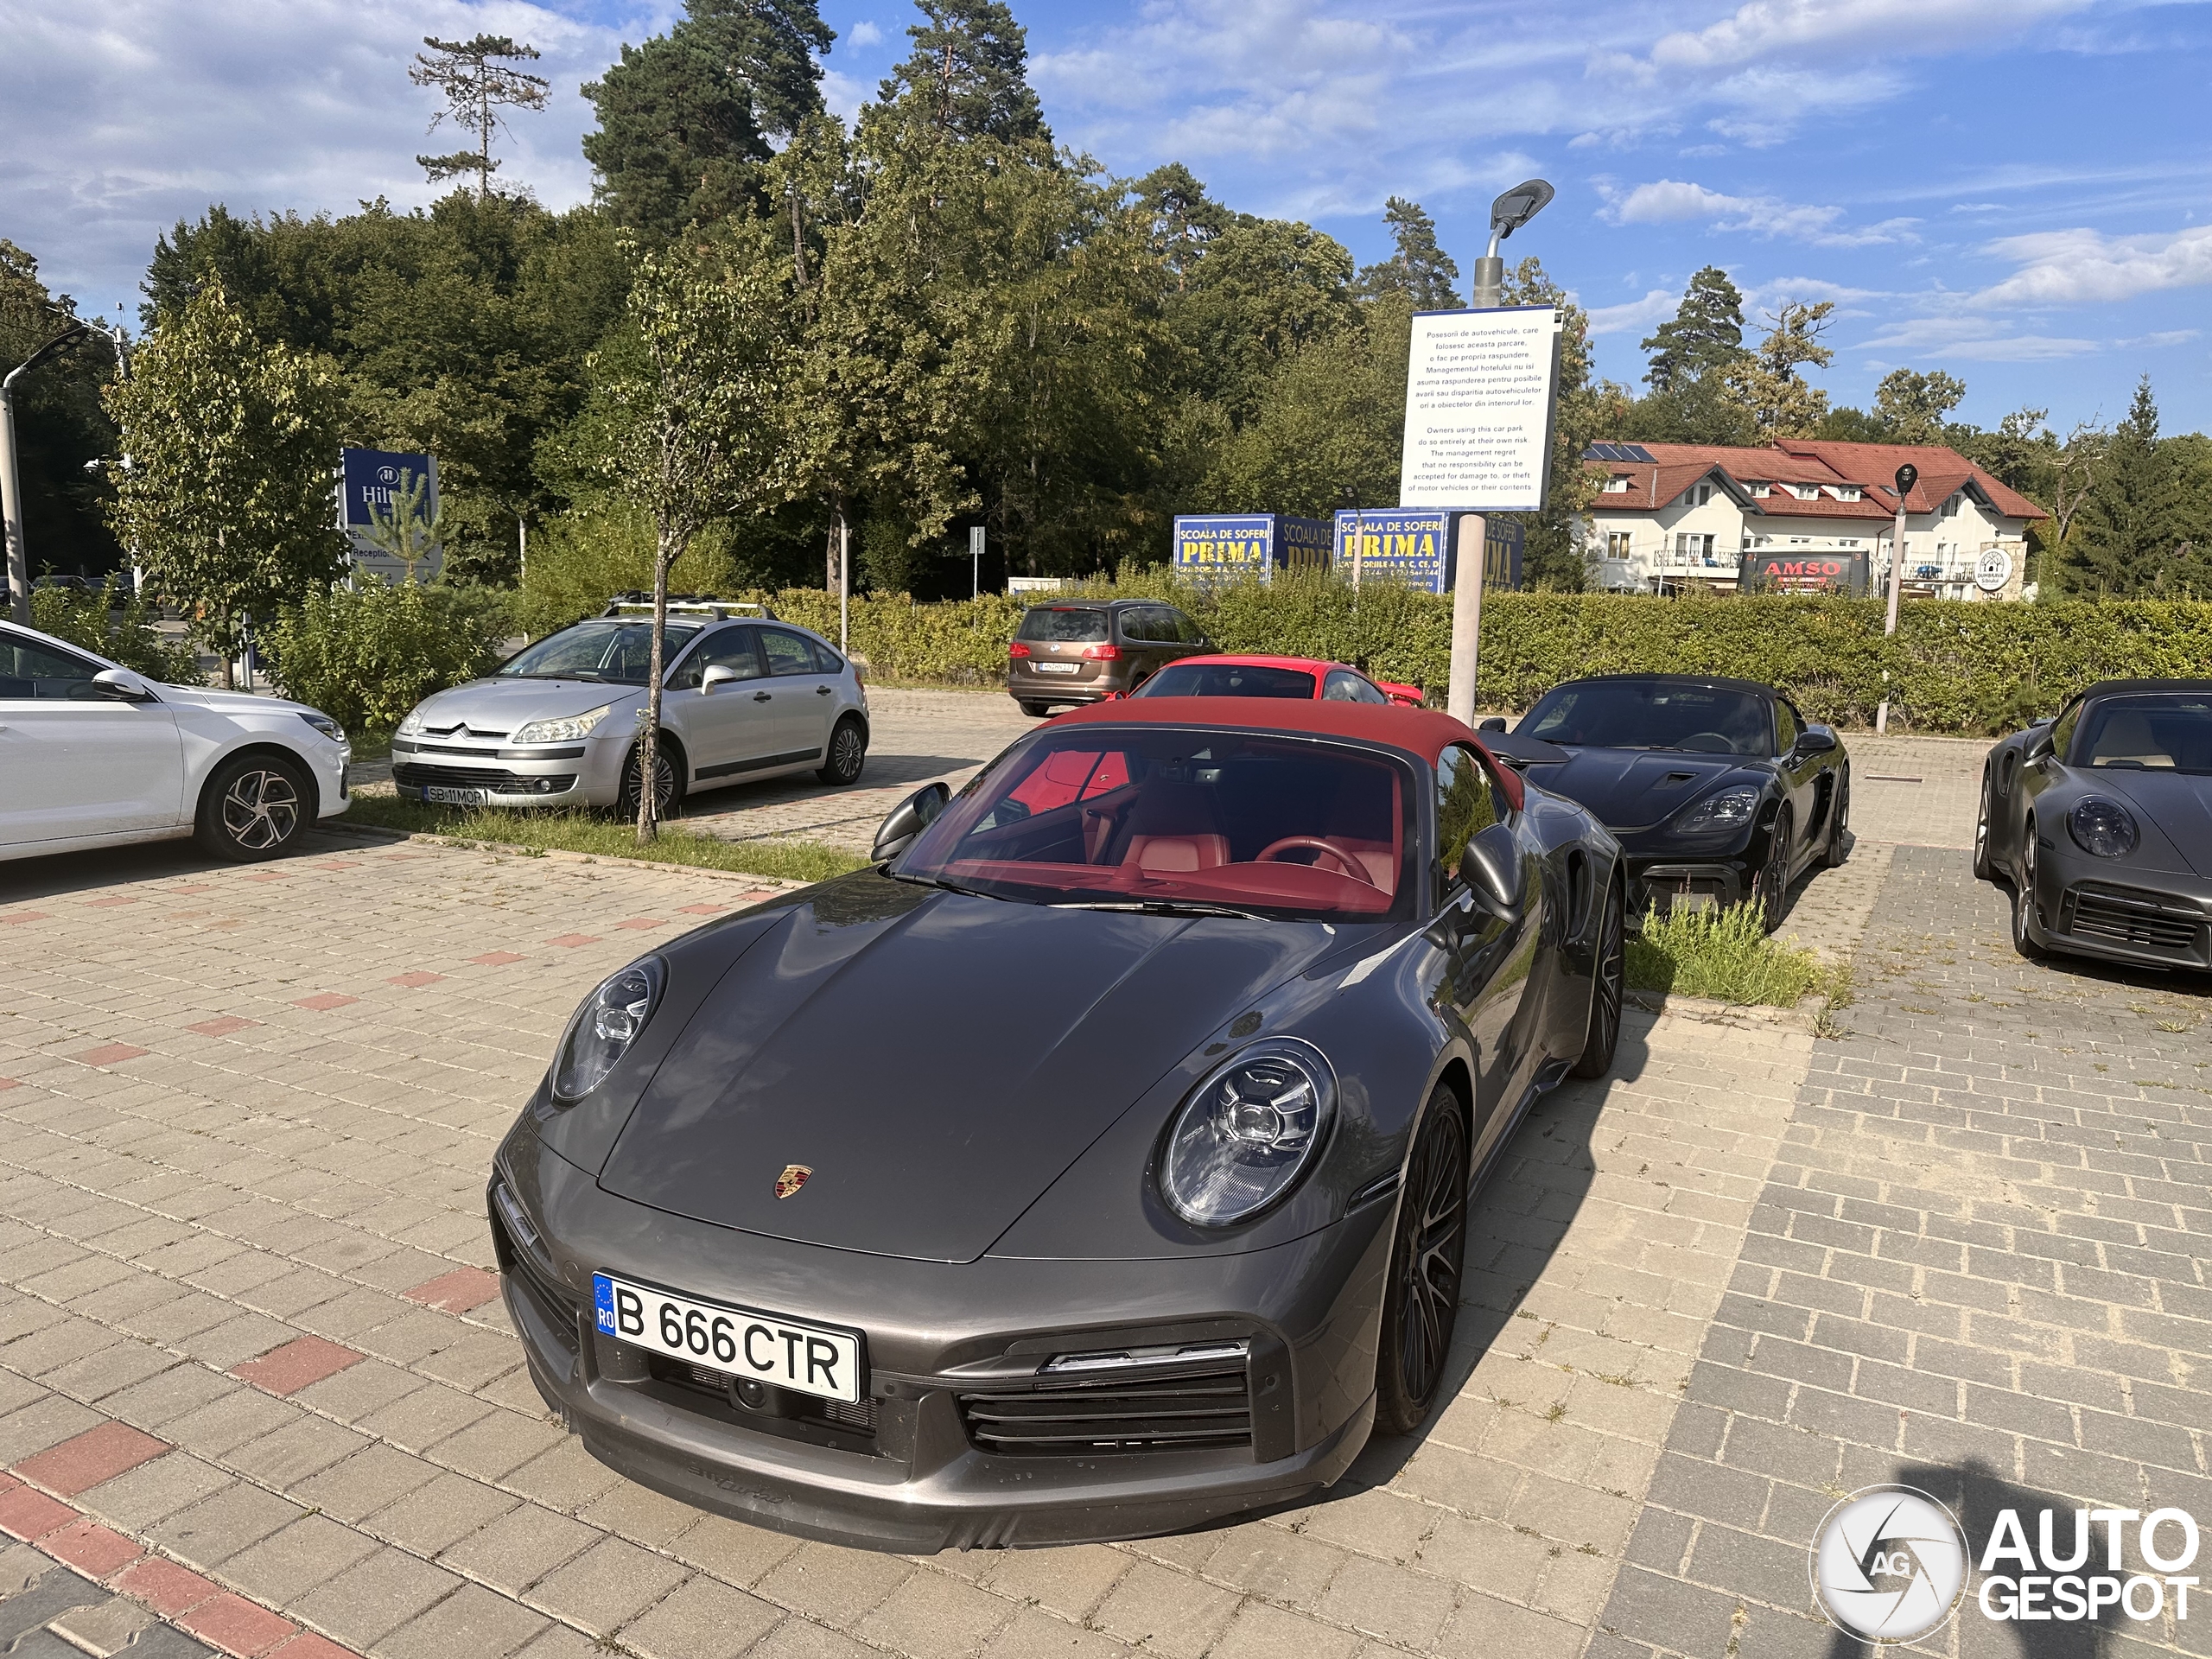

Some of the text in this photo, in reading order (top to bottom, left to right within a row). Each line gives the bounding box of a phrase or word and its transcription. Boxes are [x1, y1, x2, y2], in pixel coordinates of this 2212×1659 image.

[1426, 365, 1478, 374] Managementul
[362, 486, 415, 504] Hilt
[1180, 529, 1268, 540] SCOALA DE SOFERI
[1283, 523, 1332, 546] SCOALA DE
[1341, 521, 1441, 532] SCALA DE SOFERI
[1487, 518, 1517, 543] DE SOFERI
[1182, 541, 1262, 563] PRIMA
[1408, 560, 1417, 569] C,
[1418, 560, 1431, 569] CE,
[1764, 562, 1841, 575] AMSO
[429, 788, 445, 801] SB
[448, 789, 456, 802] 11
[598, 1306, 614, 1330] RO
[615, 1287, 839, 1390] B 666 CTR
